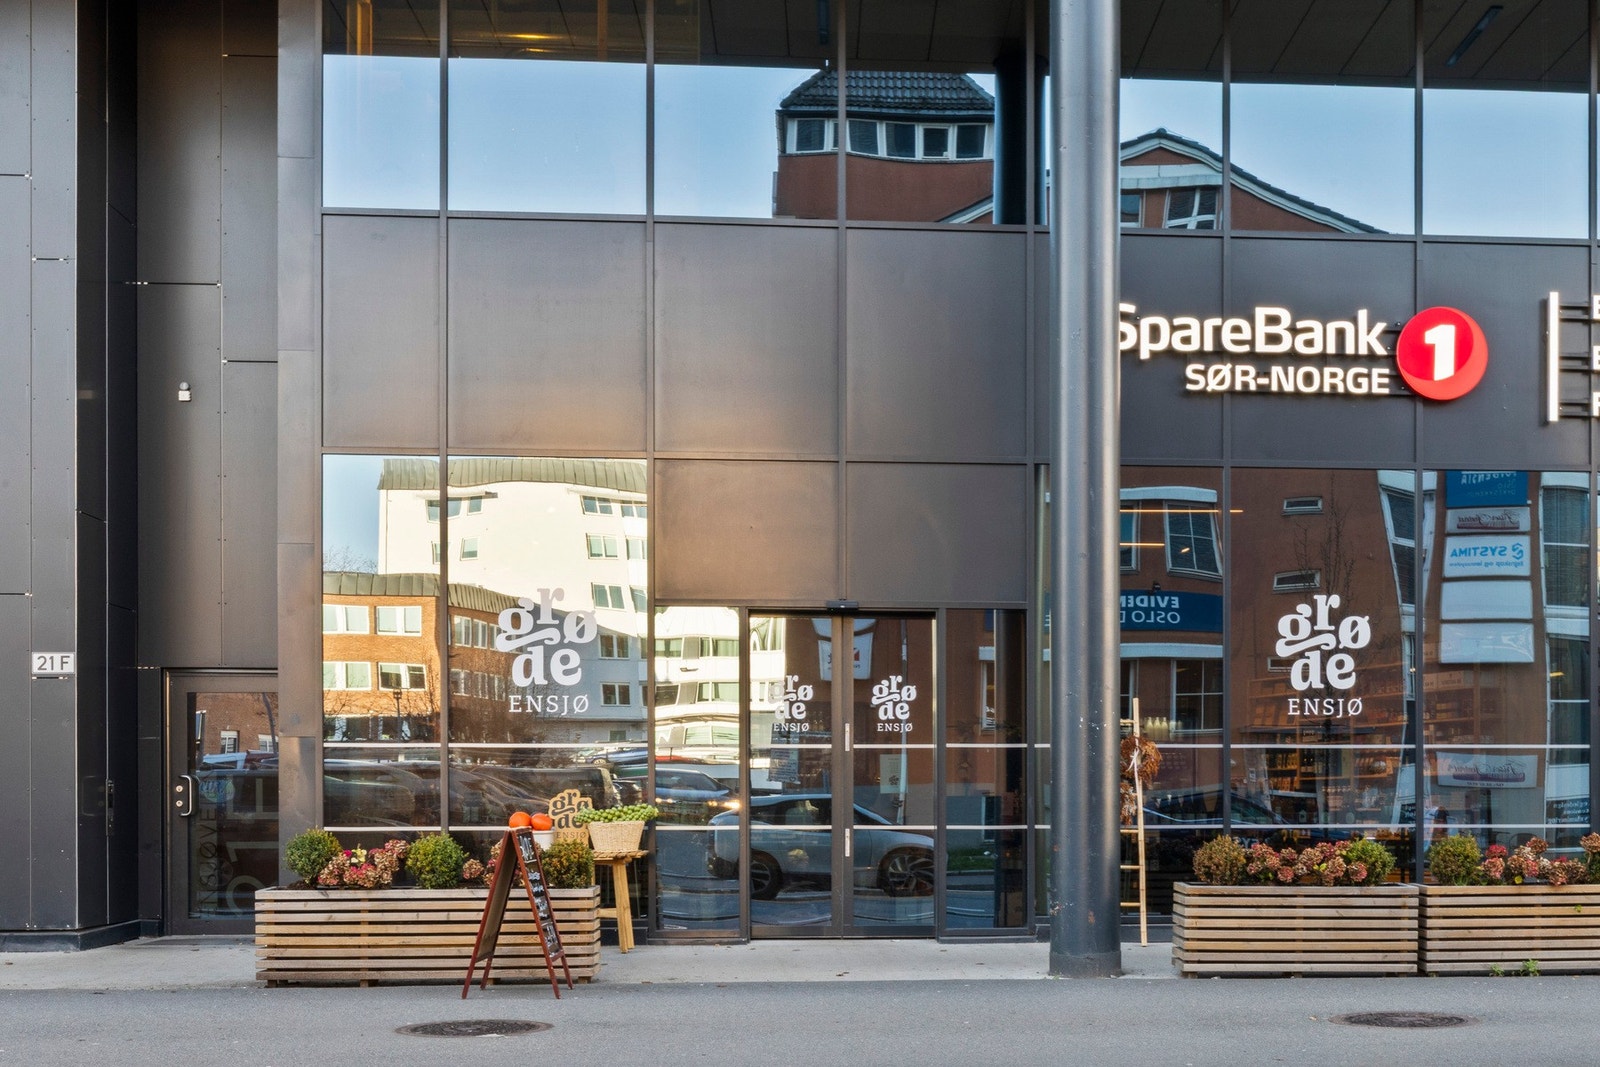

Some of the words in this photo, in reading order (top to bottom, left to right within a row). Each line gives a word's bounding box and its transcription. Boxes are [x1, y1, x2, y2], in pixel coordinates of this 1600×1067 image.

[1119, 303, 1389, 360] SpareBank
[1424, 323, 1456, 382] 1
[1185, 364, 1390, 395] SØR-NORGE
[508, 694, 589, 716] ENSJØ
[1287, 697, 1363, 718] ENSJØ
[773, 722, 810, 733] ENSJØ
[877, 722, 913, 733] ENSJØ
[556, 831, 587, 840] ENSJØ
